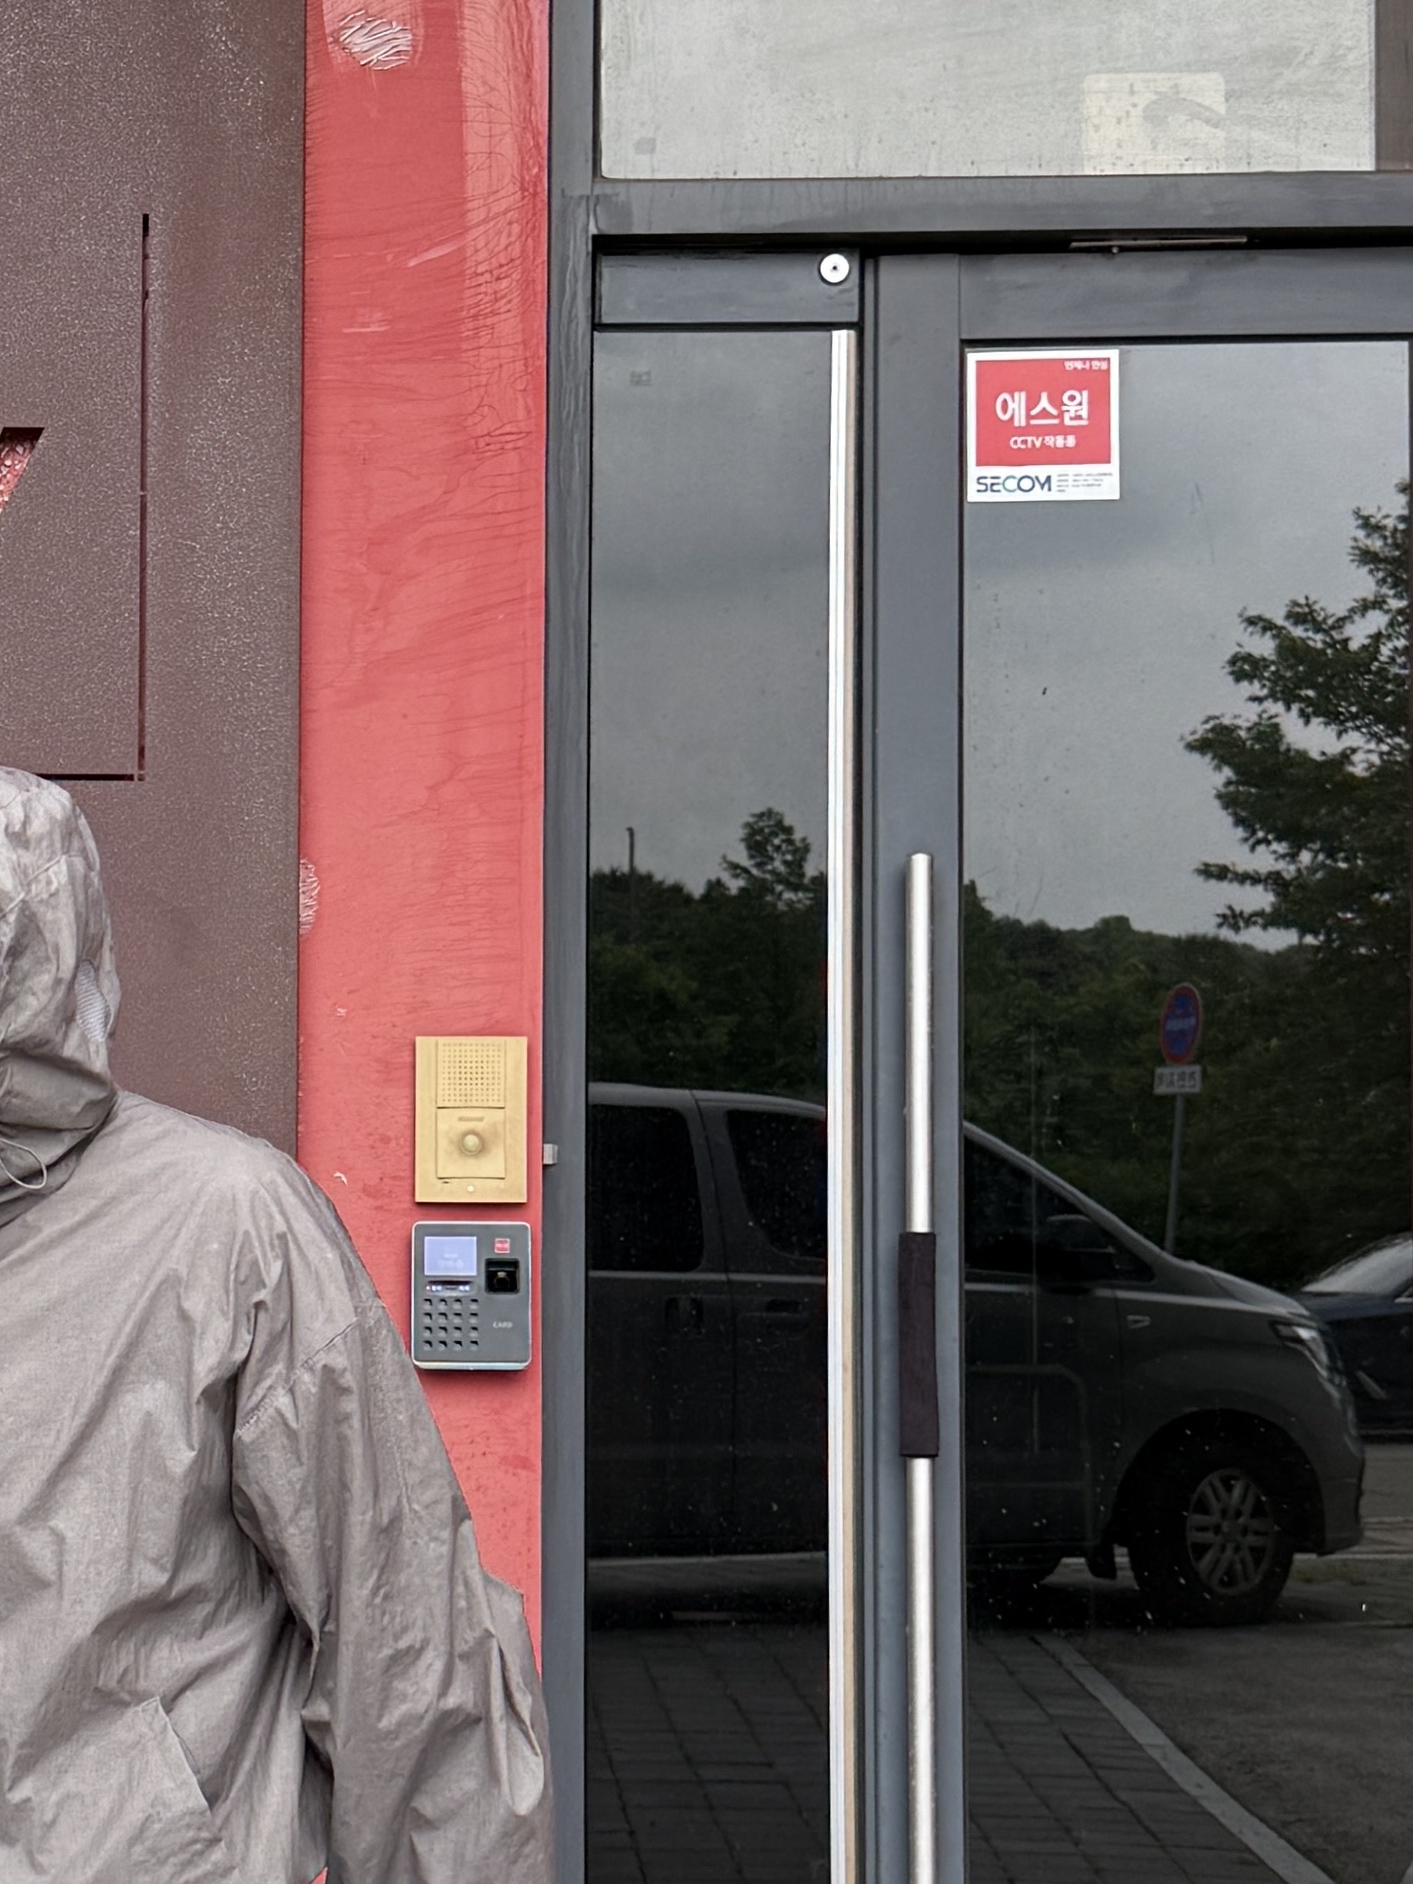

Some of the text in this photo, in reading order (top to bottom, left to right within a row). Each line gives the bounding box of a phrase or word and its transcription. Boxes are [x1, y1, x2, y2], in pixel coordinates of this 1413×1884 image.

[995, 390, 1089, 427] 에스원
[1010, 436, 1043, 449] CCTV
[976, 475, 1052, 492] SECOM
